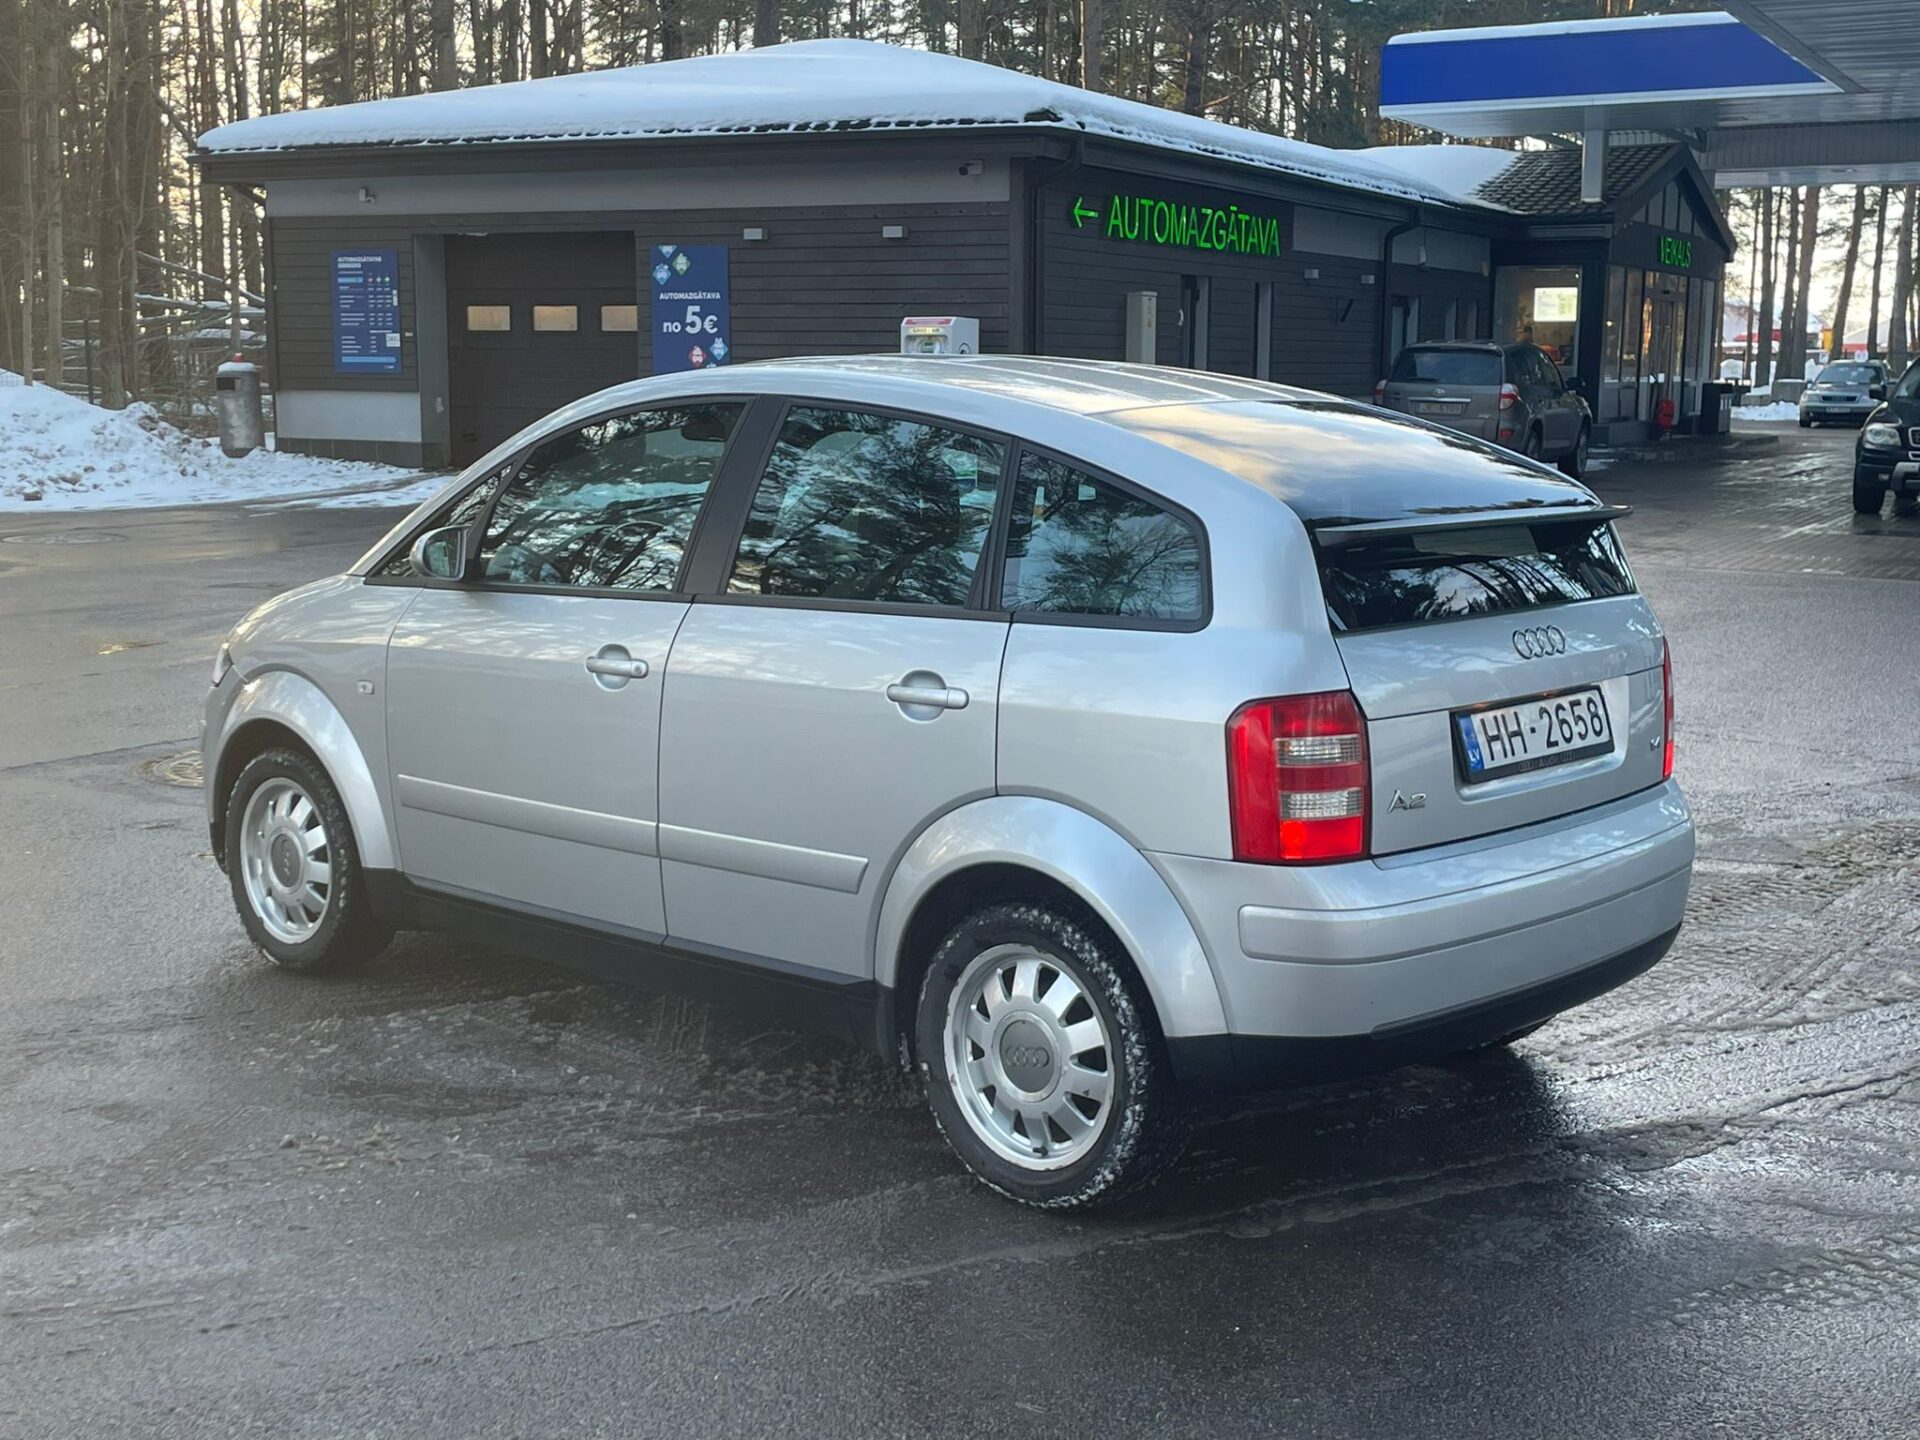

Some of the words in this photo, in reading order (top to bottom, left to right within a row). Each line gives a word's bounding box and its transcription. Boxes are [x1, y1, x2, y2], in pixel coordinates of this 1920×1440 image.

[1108, 195, 1280, 257] AUTOMAZGĀTAVA
[659, 291, 721, 300] AUTOMAZGĀTAVA
[663, 321, 681, 333] no
[1480, 697, 1604, 761] HH-2658
[1467, 748, 1480, 761] LV
[1387, 789, 1426, 812] A2
